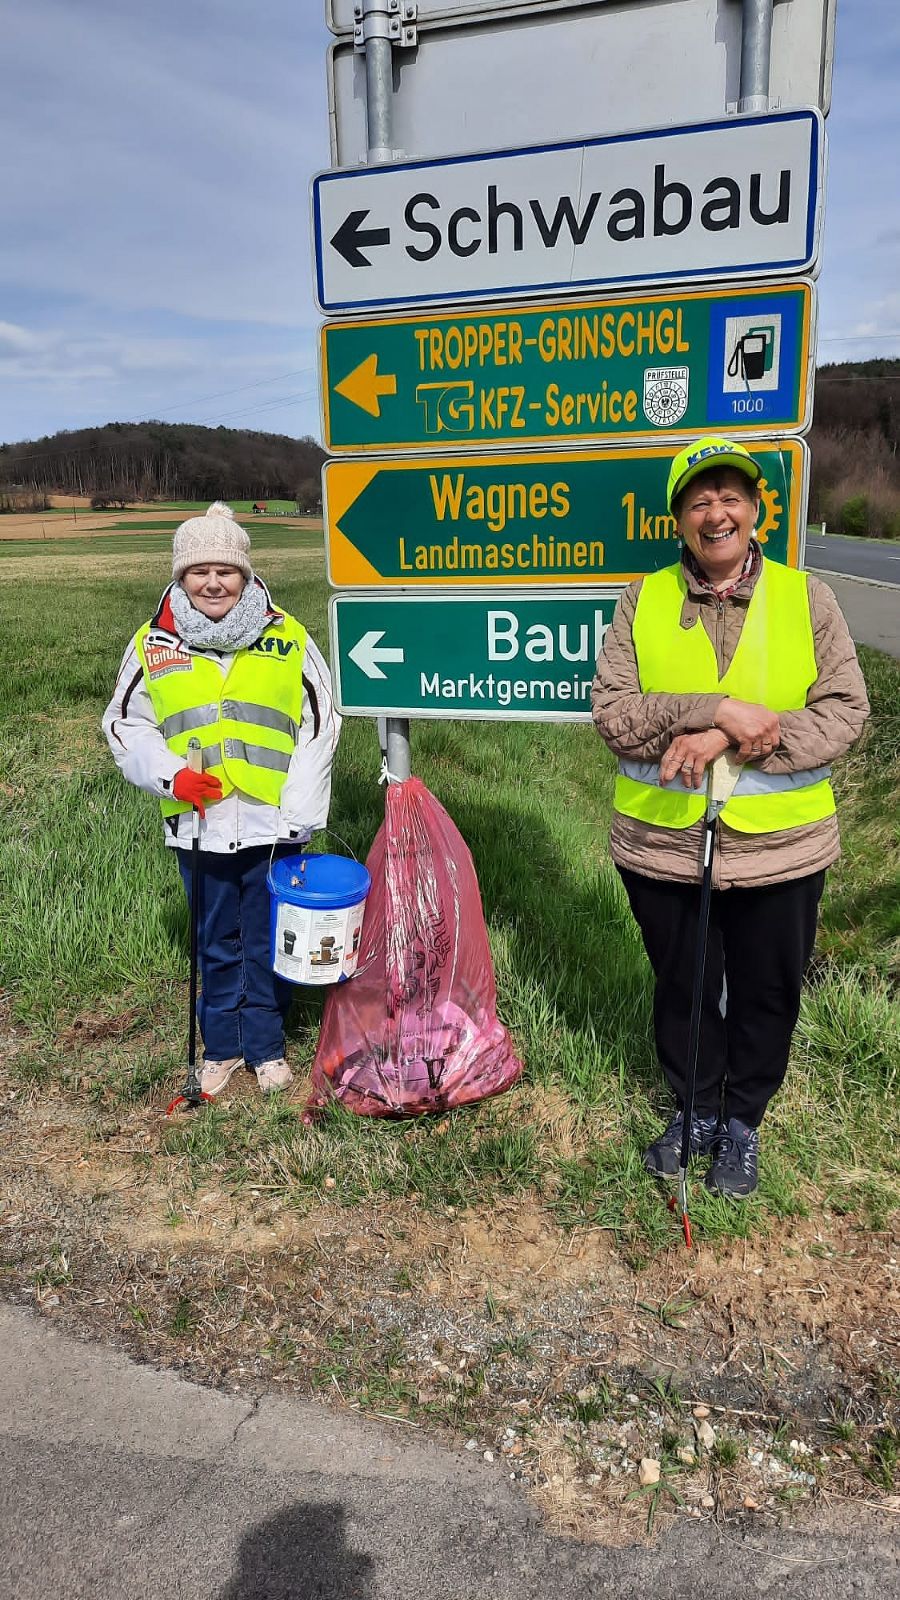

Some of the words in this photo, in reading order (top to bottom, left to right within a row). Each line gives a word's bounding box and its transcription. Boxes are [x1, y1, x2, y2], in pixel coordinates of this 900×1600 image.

[405, 164, 790, 262] Schwabau
[415, 308, 689, 370] TROPPER-GRINSCHGL
[732, 398, 764, 414] 1000
[429, 473, 570, 531] Wagnes
[399, 536, 604, 570] Landmaschinen
